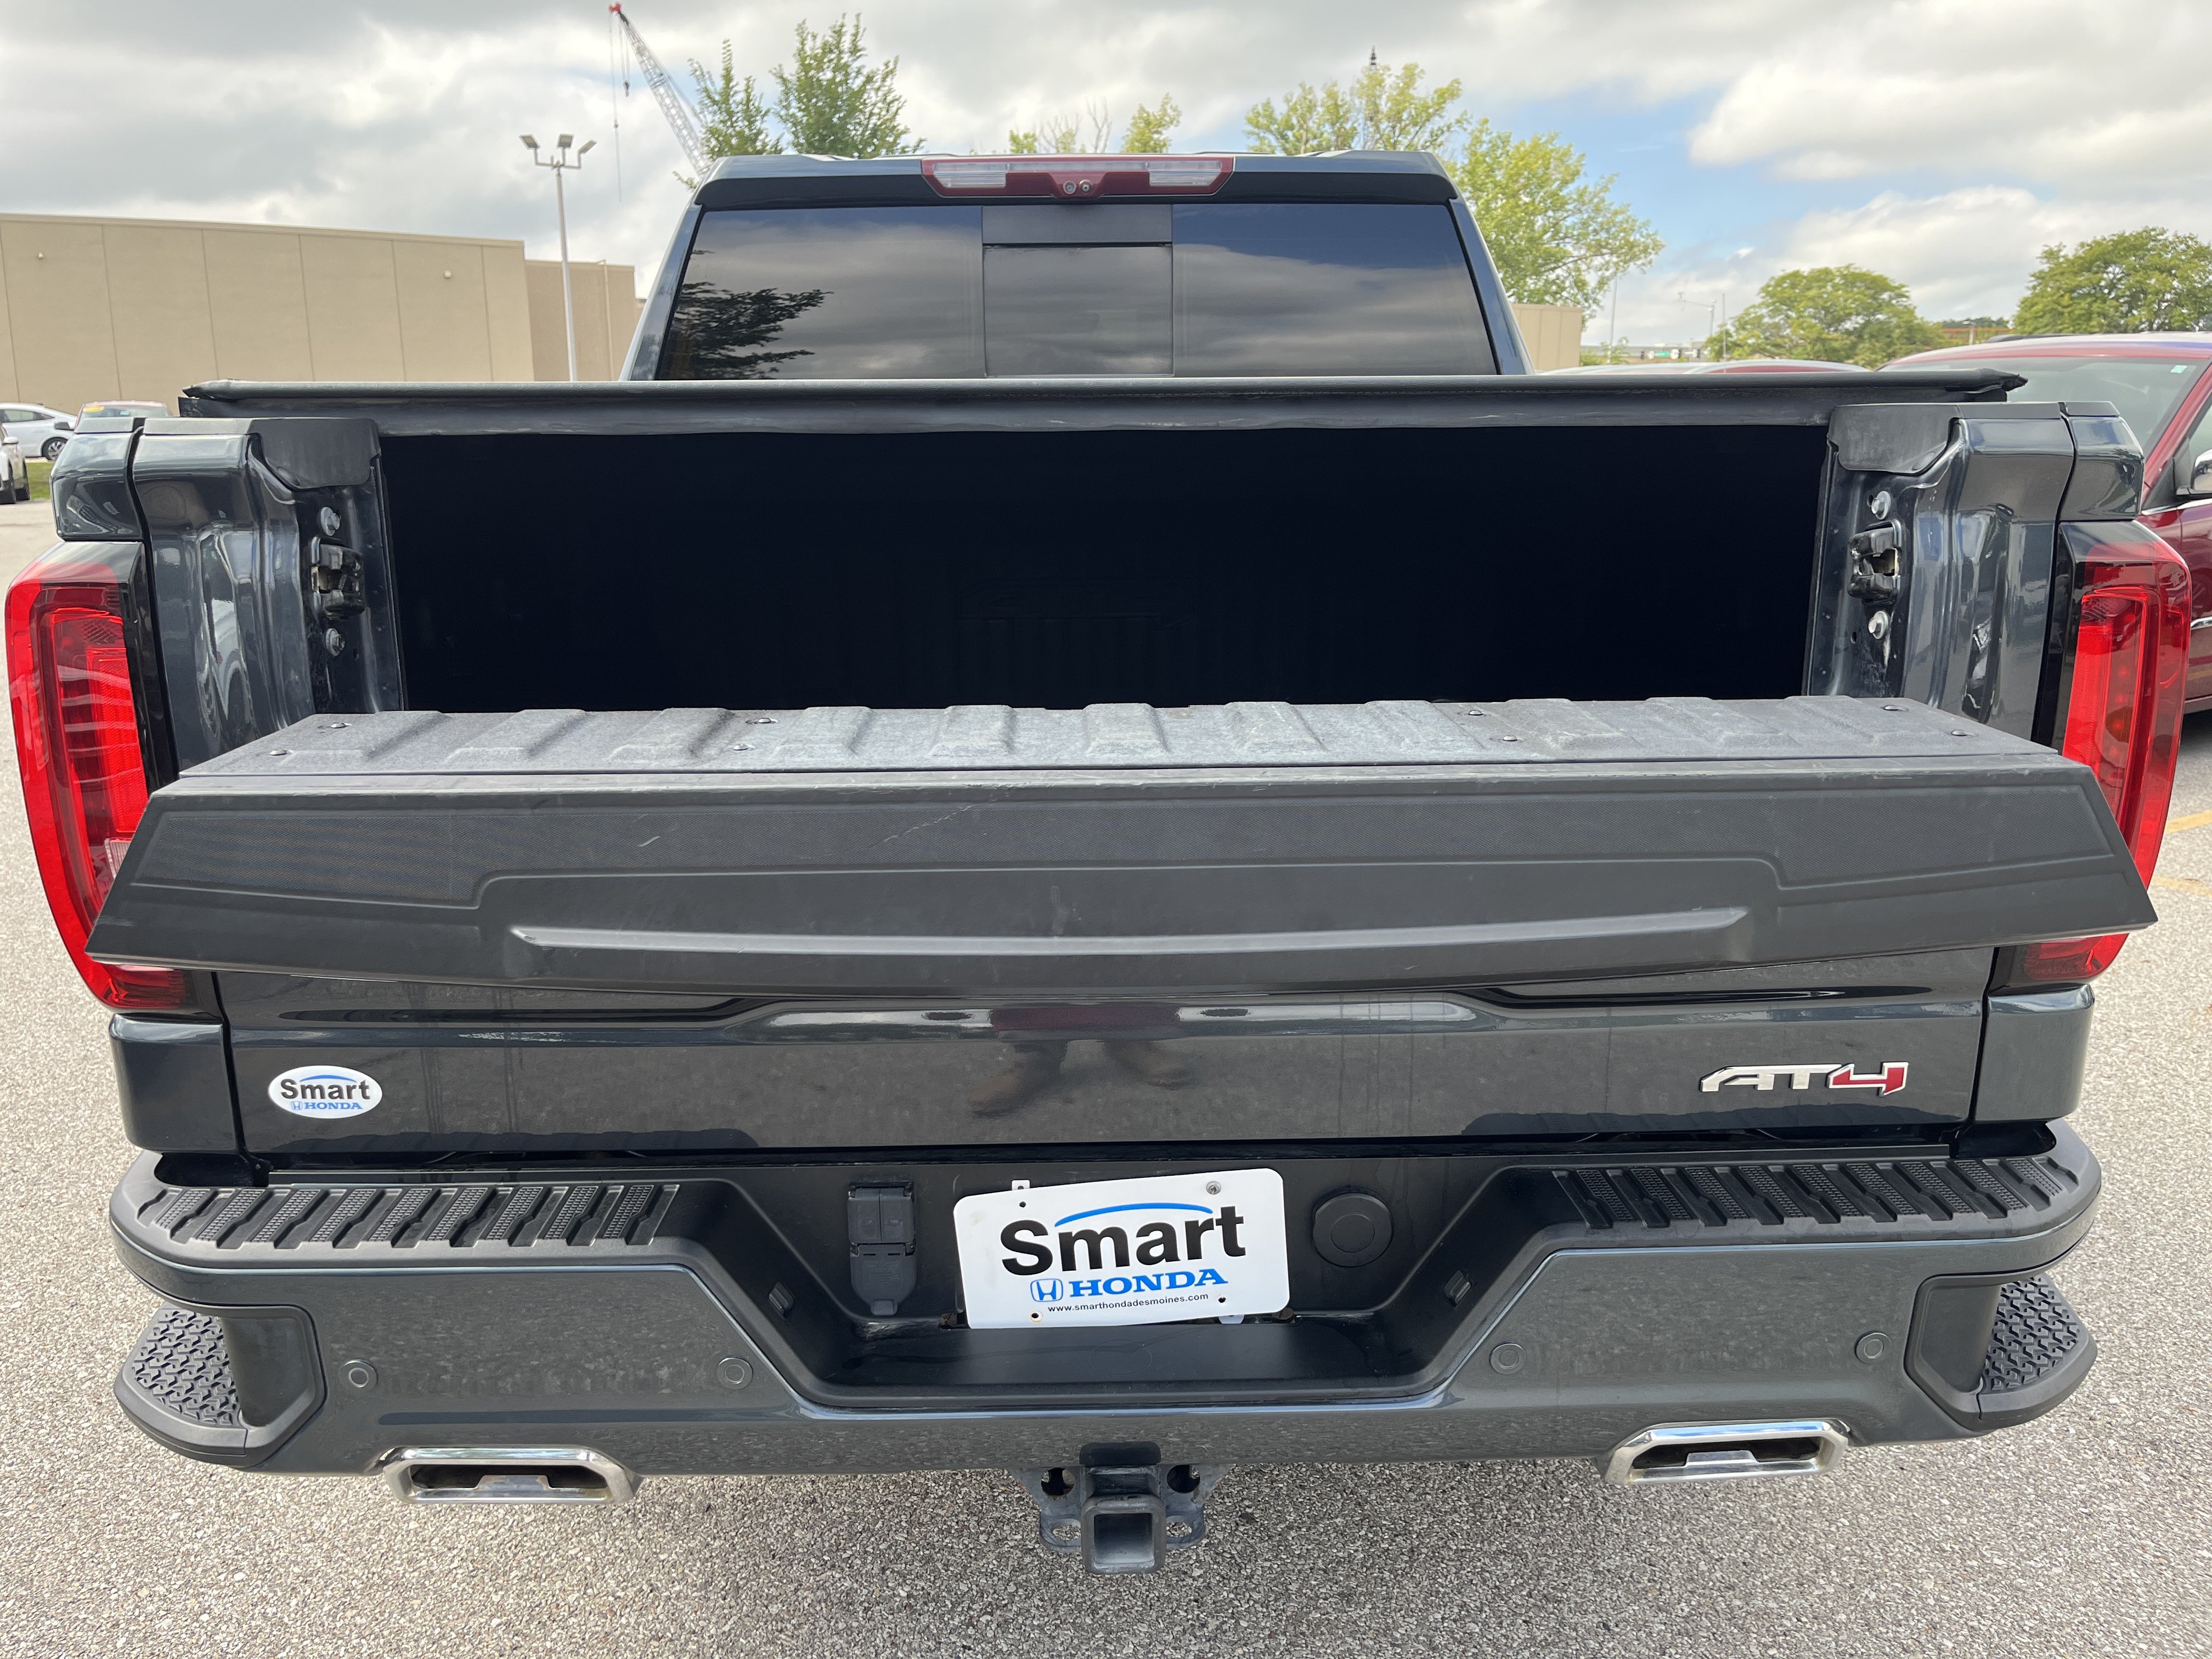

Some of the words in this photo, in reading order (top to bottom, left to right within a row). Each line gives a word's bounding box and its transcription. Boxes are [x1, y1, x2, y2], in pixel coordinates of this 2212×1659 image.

[280, 1079, 370, 1099] Smart
[1700, 1062, 1909, 1096] AT4
[1000, 1205, 1246, 1276] Smart
[1068, 1268, 1228, 1297] HONDA
[1047, 1292, 1209, 1313] www.smarthondadesmoines.com
